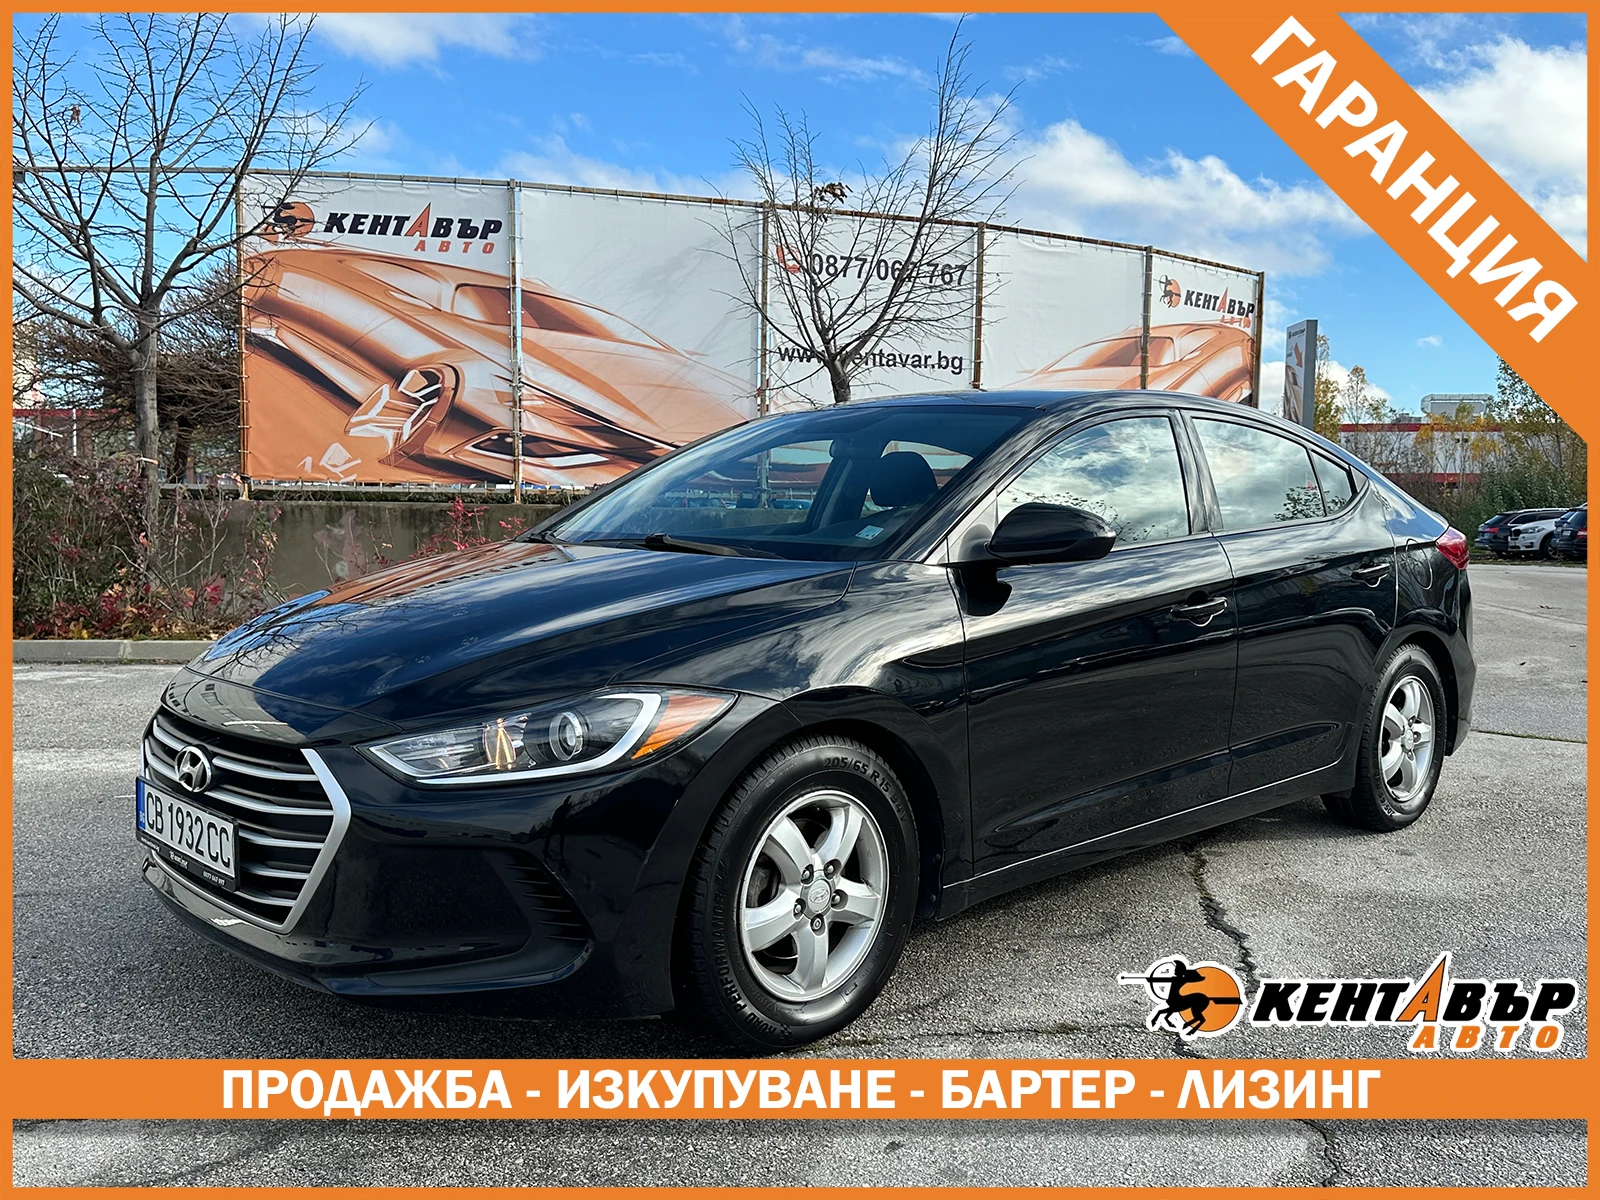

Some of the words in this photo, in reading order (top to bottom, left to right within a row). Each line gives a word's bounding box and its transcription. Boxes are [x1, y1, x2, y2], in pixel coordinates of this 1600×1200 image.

[324, 202, 503, 240] КЕНТАВЪР
[414, 240, 495, 254] АВТО
[1184, 286, 1255, 318] КЕНТАВЪР
[824, 756, 869, 775] 205/65
[745, 1012, 778, 1035] ROAD
